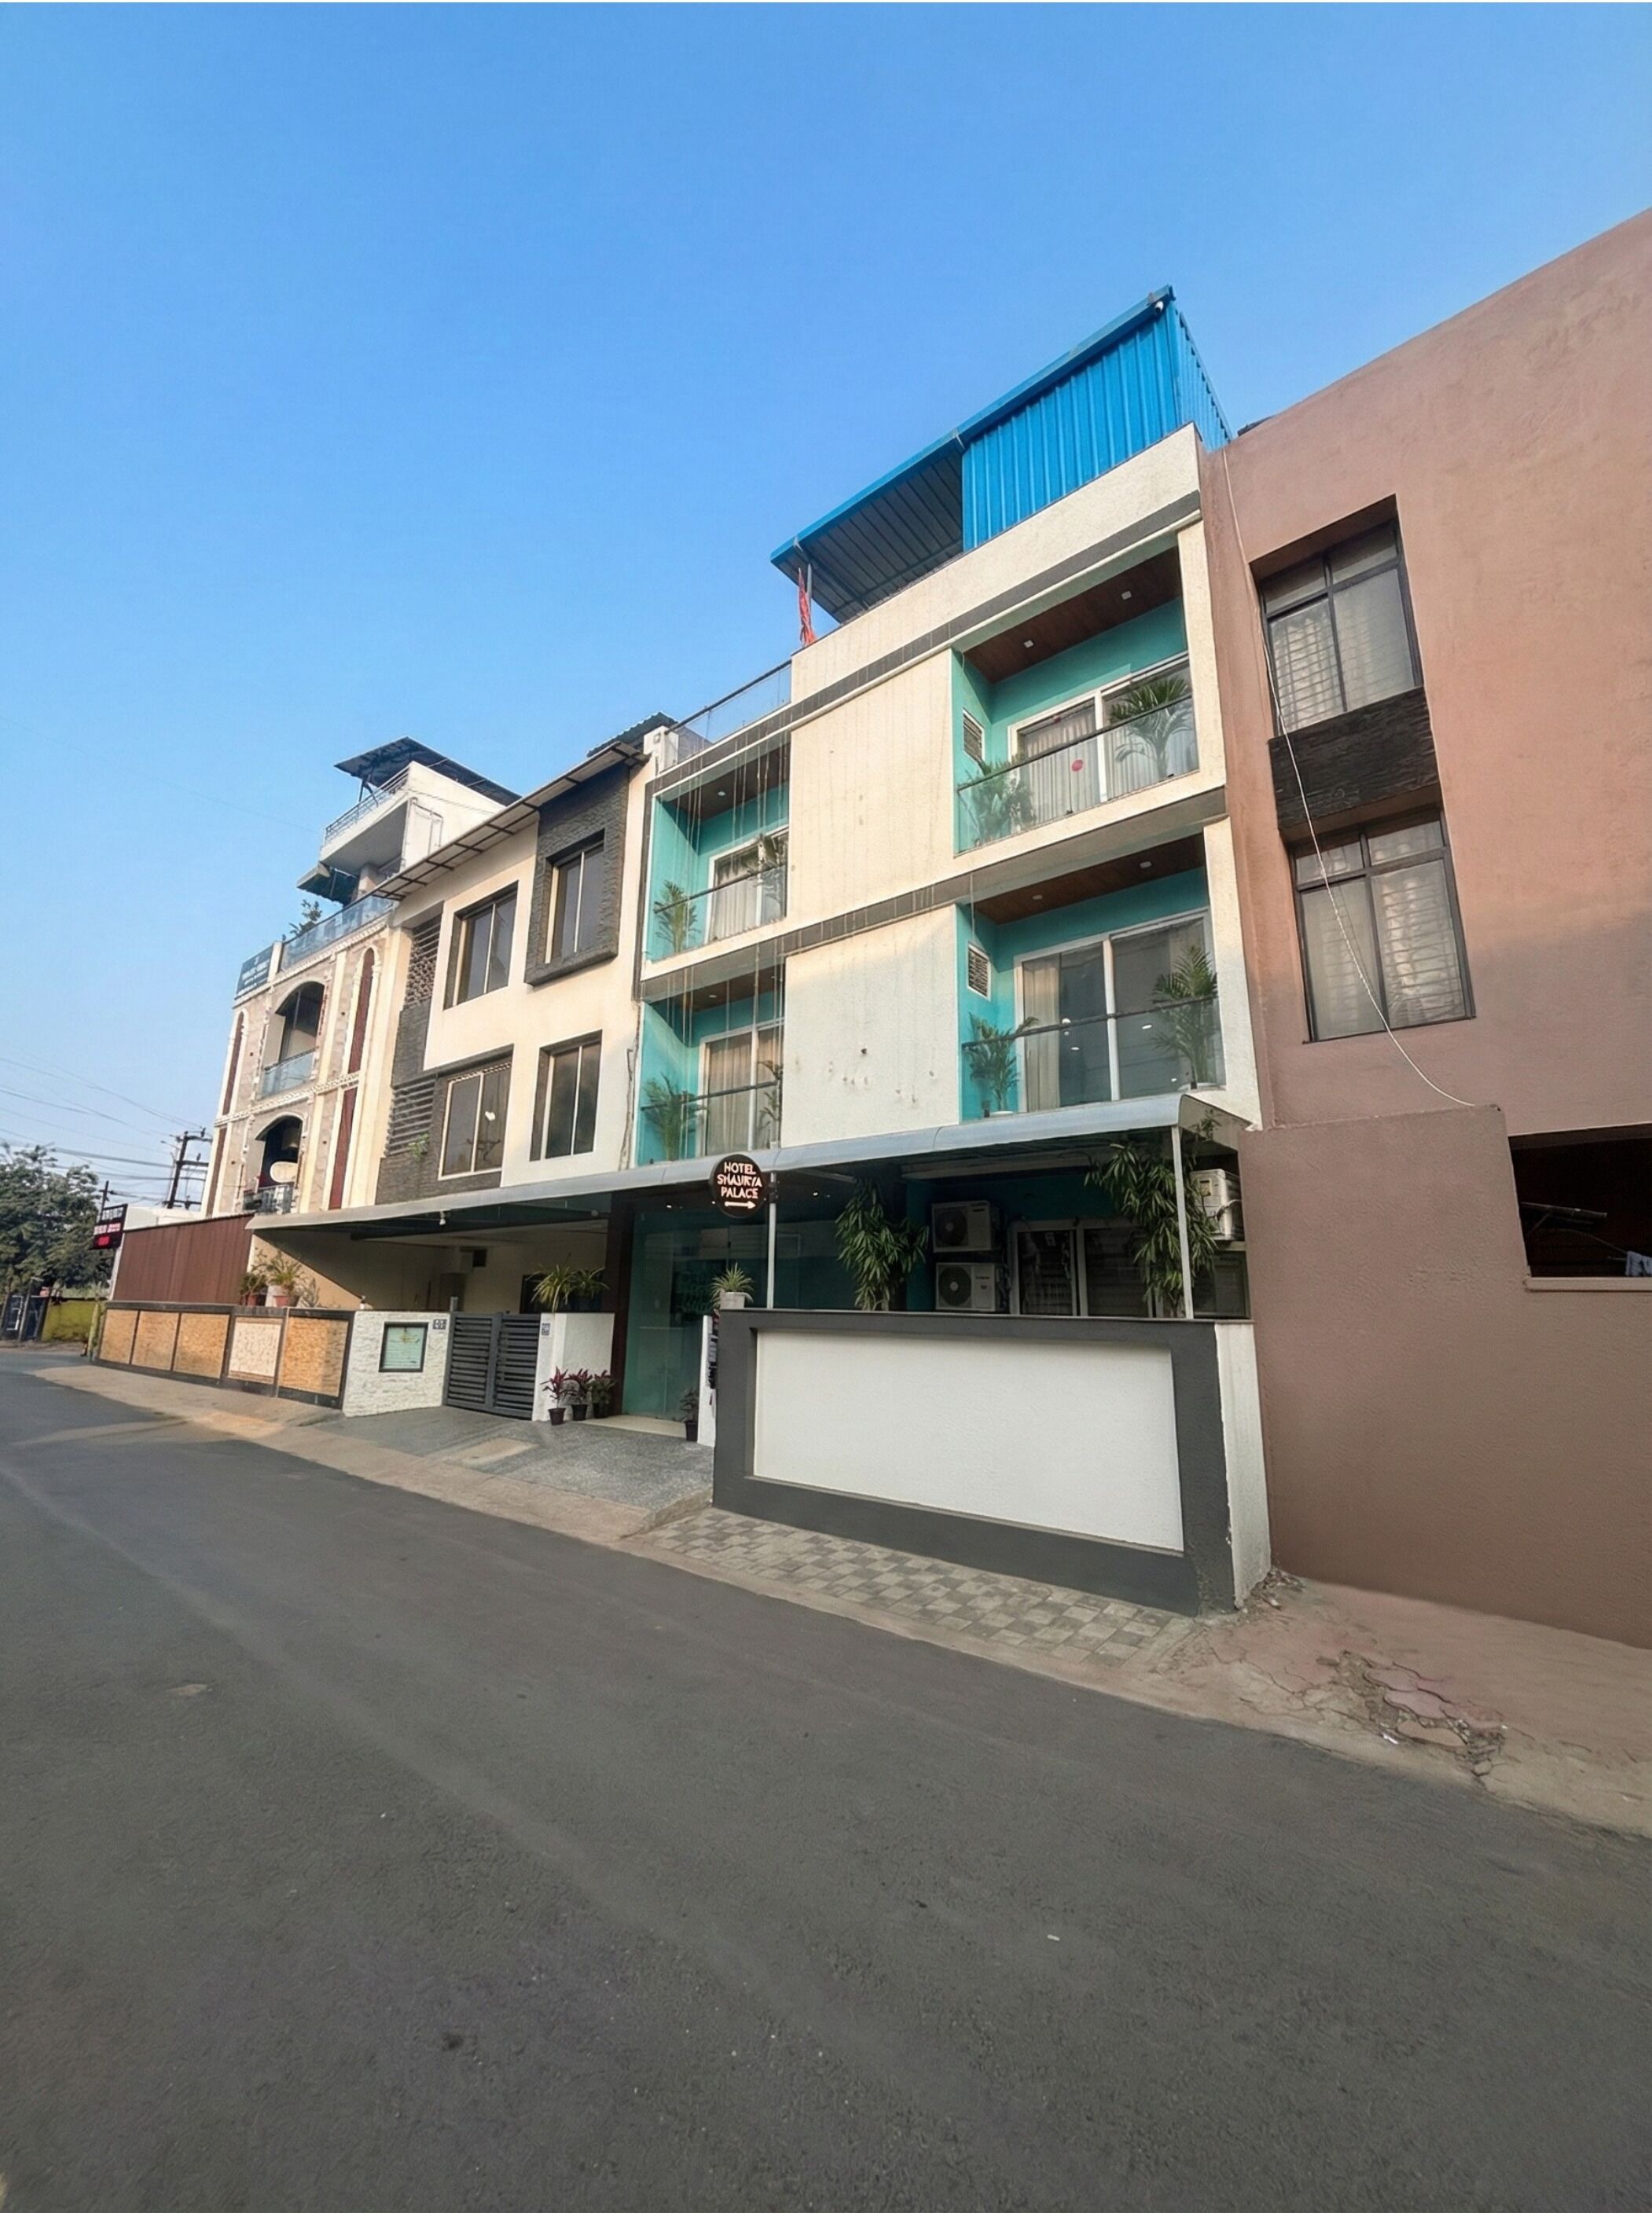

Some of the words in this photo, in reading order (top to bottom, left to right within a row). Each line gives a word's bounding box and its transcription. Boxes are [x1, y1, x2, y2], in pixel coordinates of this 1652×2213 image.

[724, 1162, 756, 1175] HOTEL
[716, 1173, 762, 1187] SHAURYA
[721, 1186, 758, 1199] PALACE
